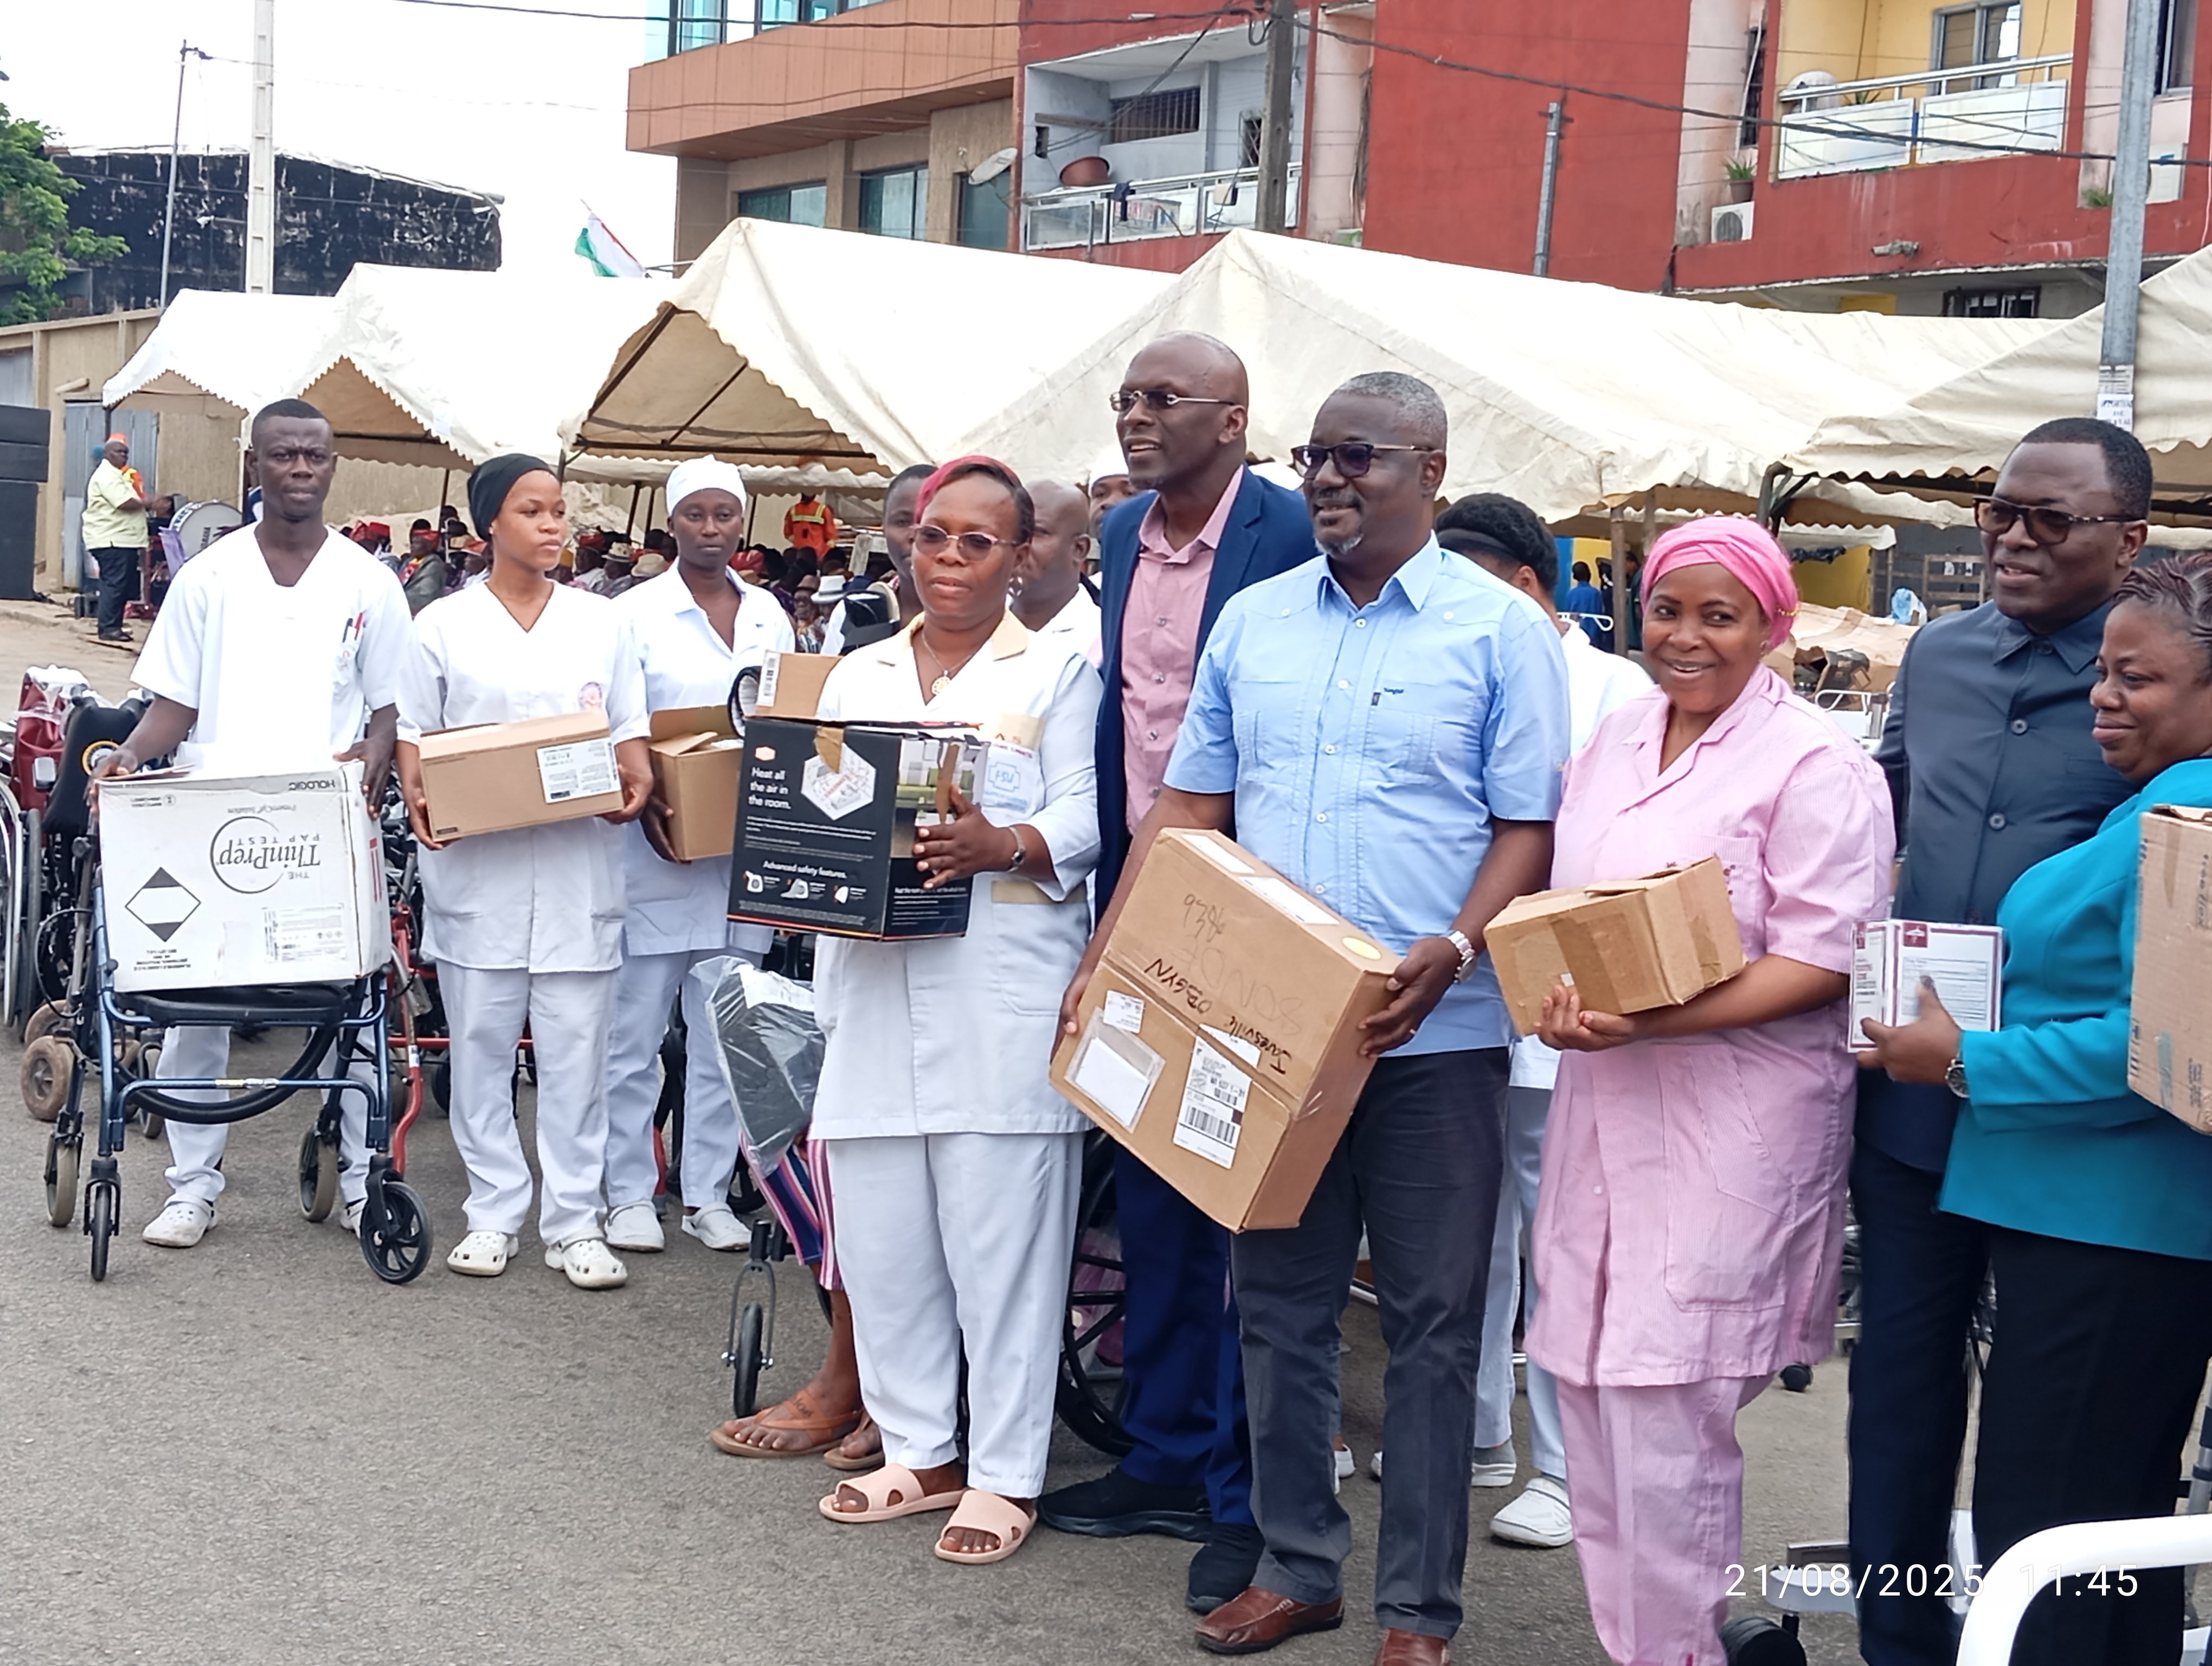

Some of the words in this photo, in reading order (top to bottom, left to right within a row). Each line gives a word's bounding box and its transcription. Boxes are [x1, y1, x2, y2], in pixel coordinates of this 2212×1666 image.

[751, 766, 773, 779] Heat
[774, 770, 786, 780] all
[288, 779, 335, 791] HOLOGIC
[750, 781, 765, 792] the
[766, 783, 779, 793] air
[779, 784, 788, 794] in
[748, 794, 763, 806] the
[764, 799, 791, 810] room.
[237, 836, 280, 846] TEST
[289, 833, 320, 843] PAP
[219, 839, 321, 869] ThinPrep
[763, 860, 797, 872] Advanced
[798, 864, 817, 876] safety
[287, 871, 310, 880] THE
[1144, 958, 1213, 1014] OBGYN
